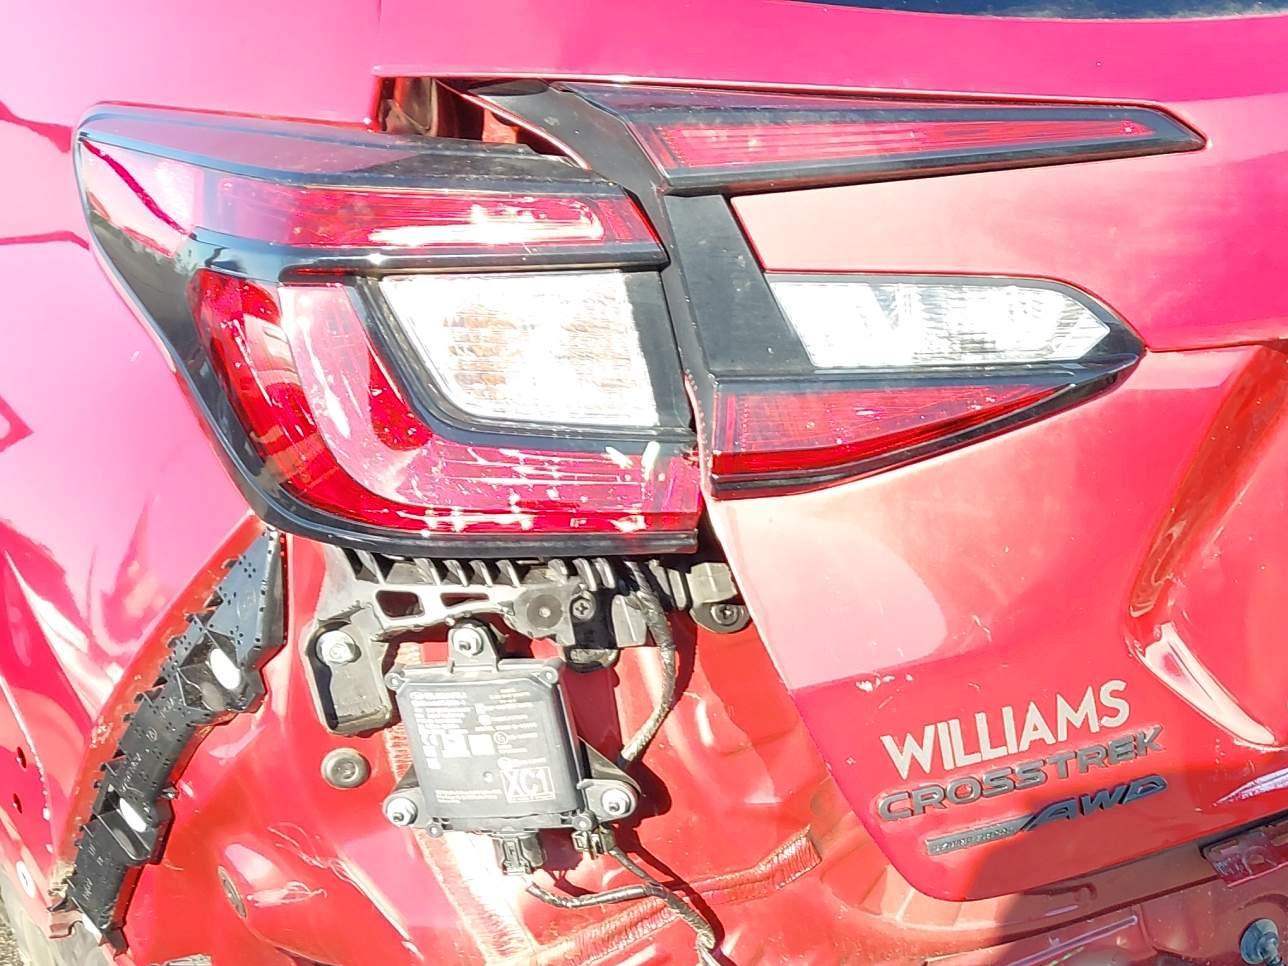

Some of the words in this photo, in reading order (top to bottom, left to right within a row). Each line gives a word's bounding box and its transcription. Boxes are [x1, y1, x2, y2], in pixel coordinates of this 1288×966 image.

[879, 680, 1130, 780] WILLIAMS
[506, 767, 549, 799] XC1
[877, 725, 1164, 822] CROSSTREK
[1022, 774, 1168, 832] AWD
